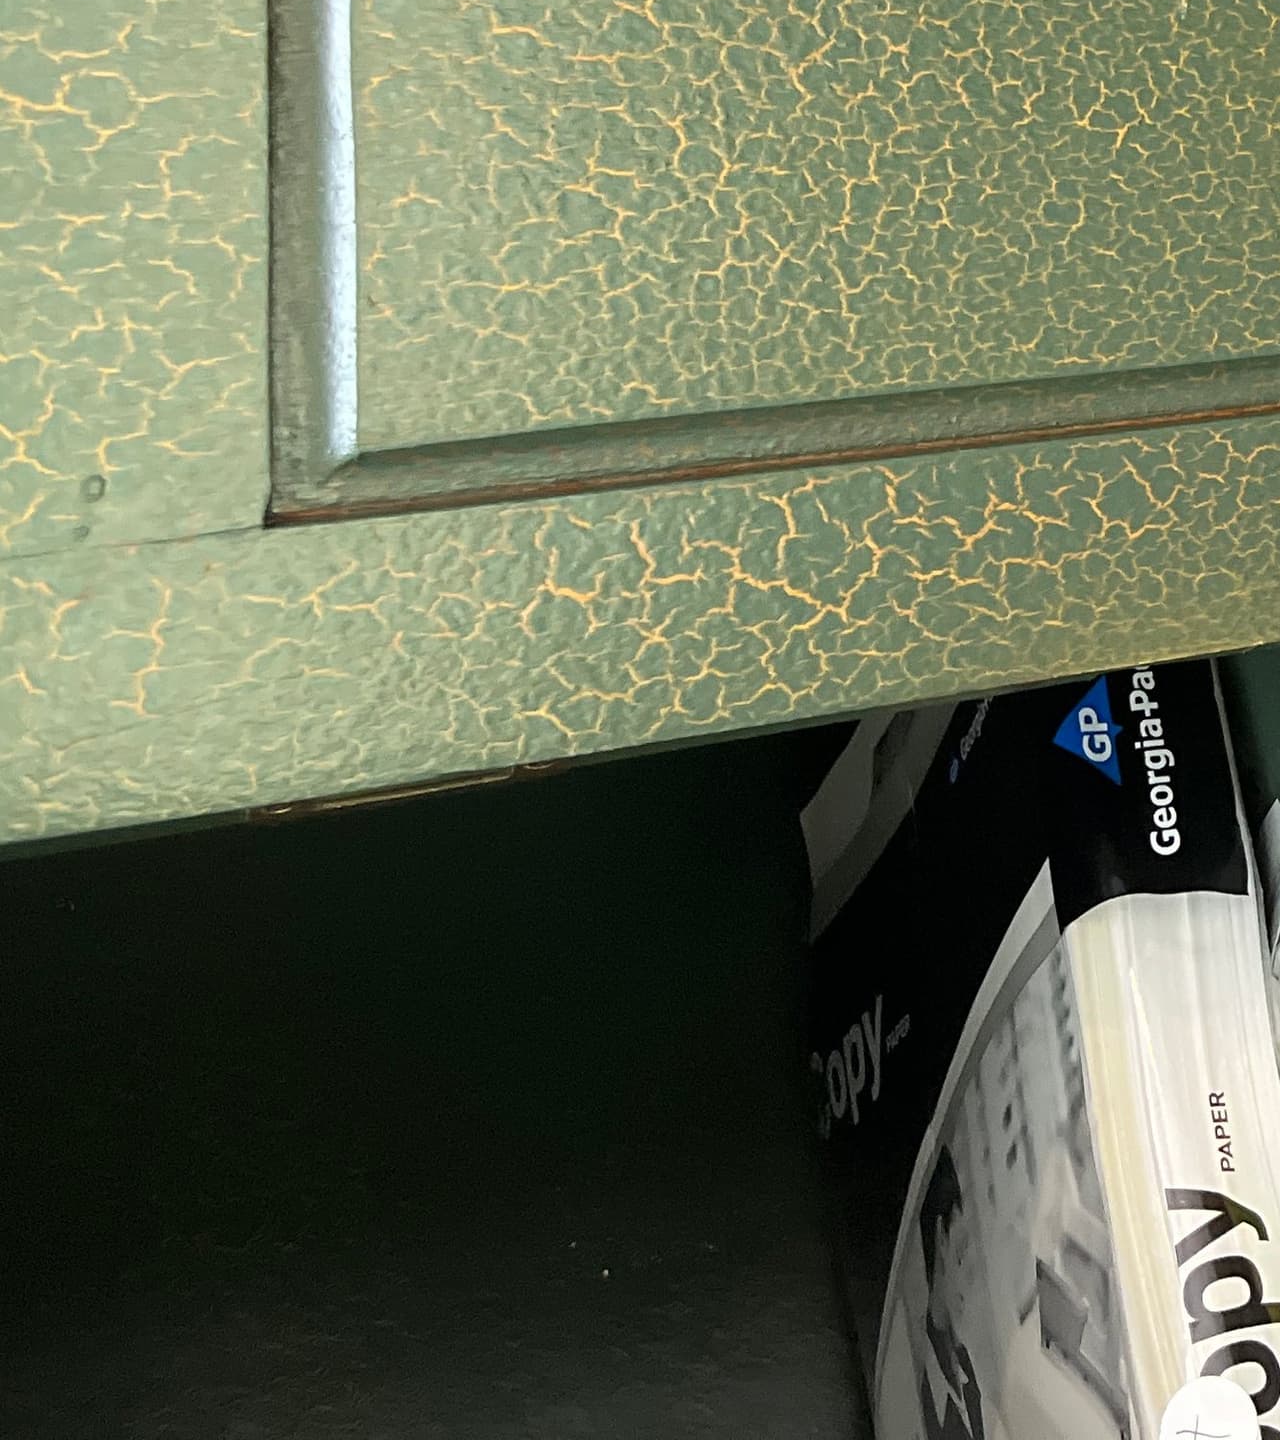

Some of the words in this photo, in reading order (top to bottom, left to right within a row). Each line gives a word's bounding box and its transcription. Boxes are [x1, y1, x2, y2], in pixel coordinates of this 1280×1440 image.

[1078, 707, 1113, 763] GP
[1128, 666, 1181, 856] Georgia-Pa
[1208, 1090, 1236, 1173] PAPER
